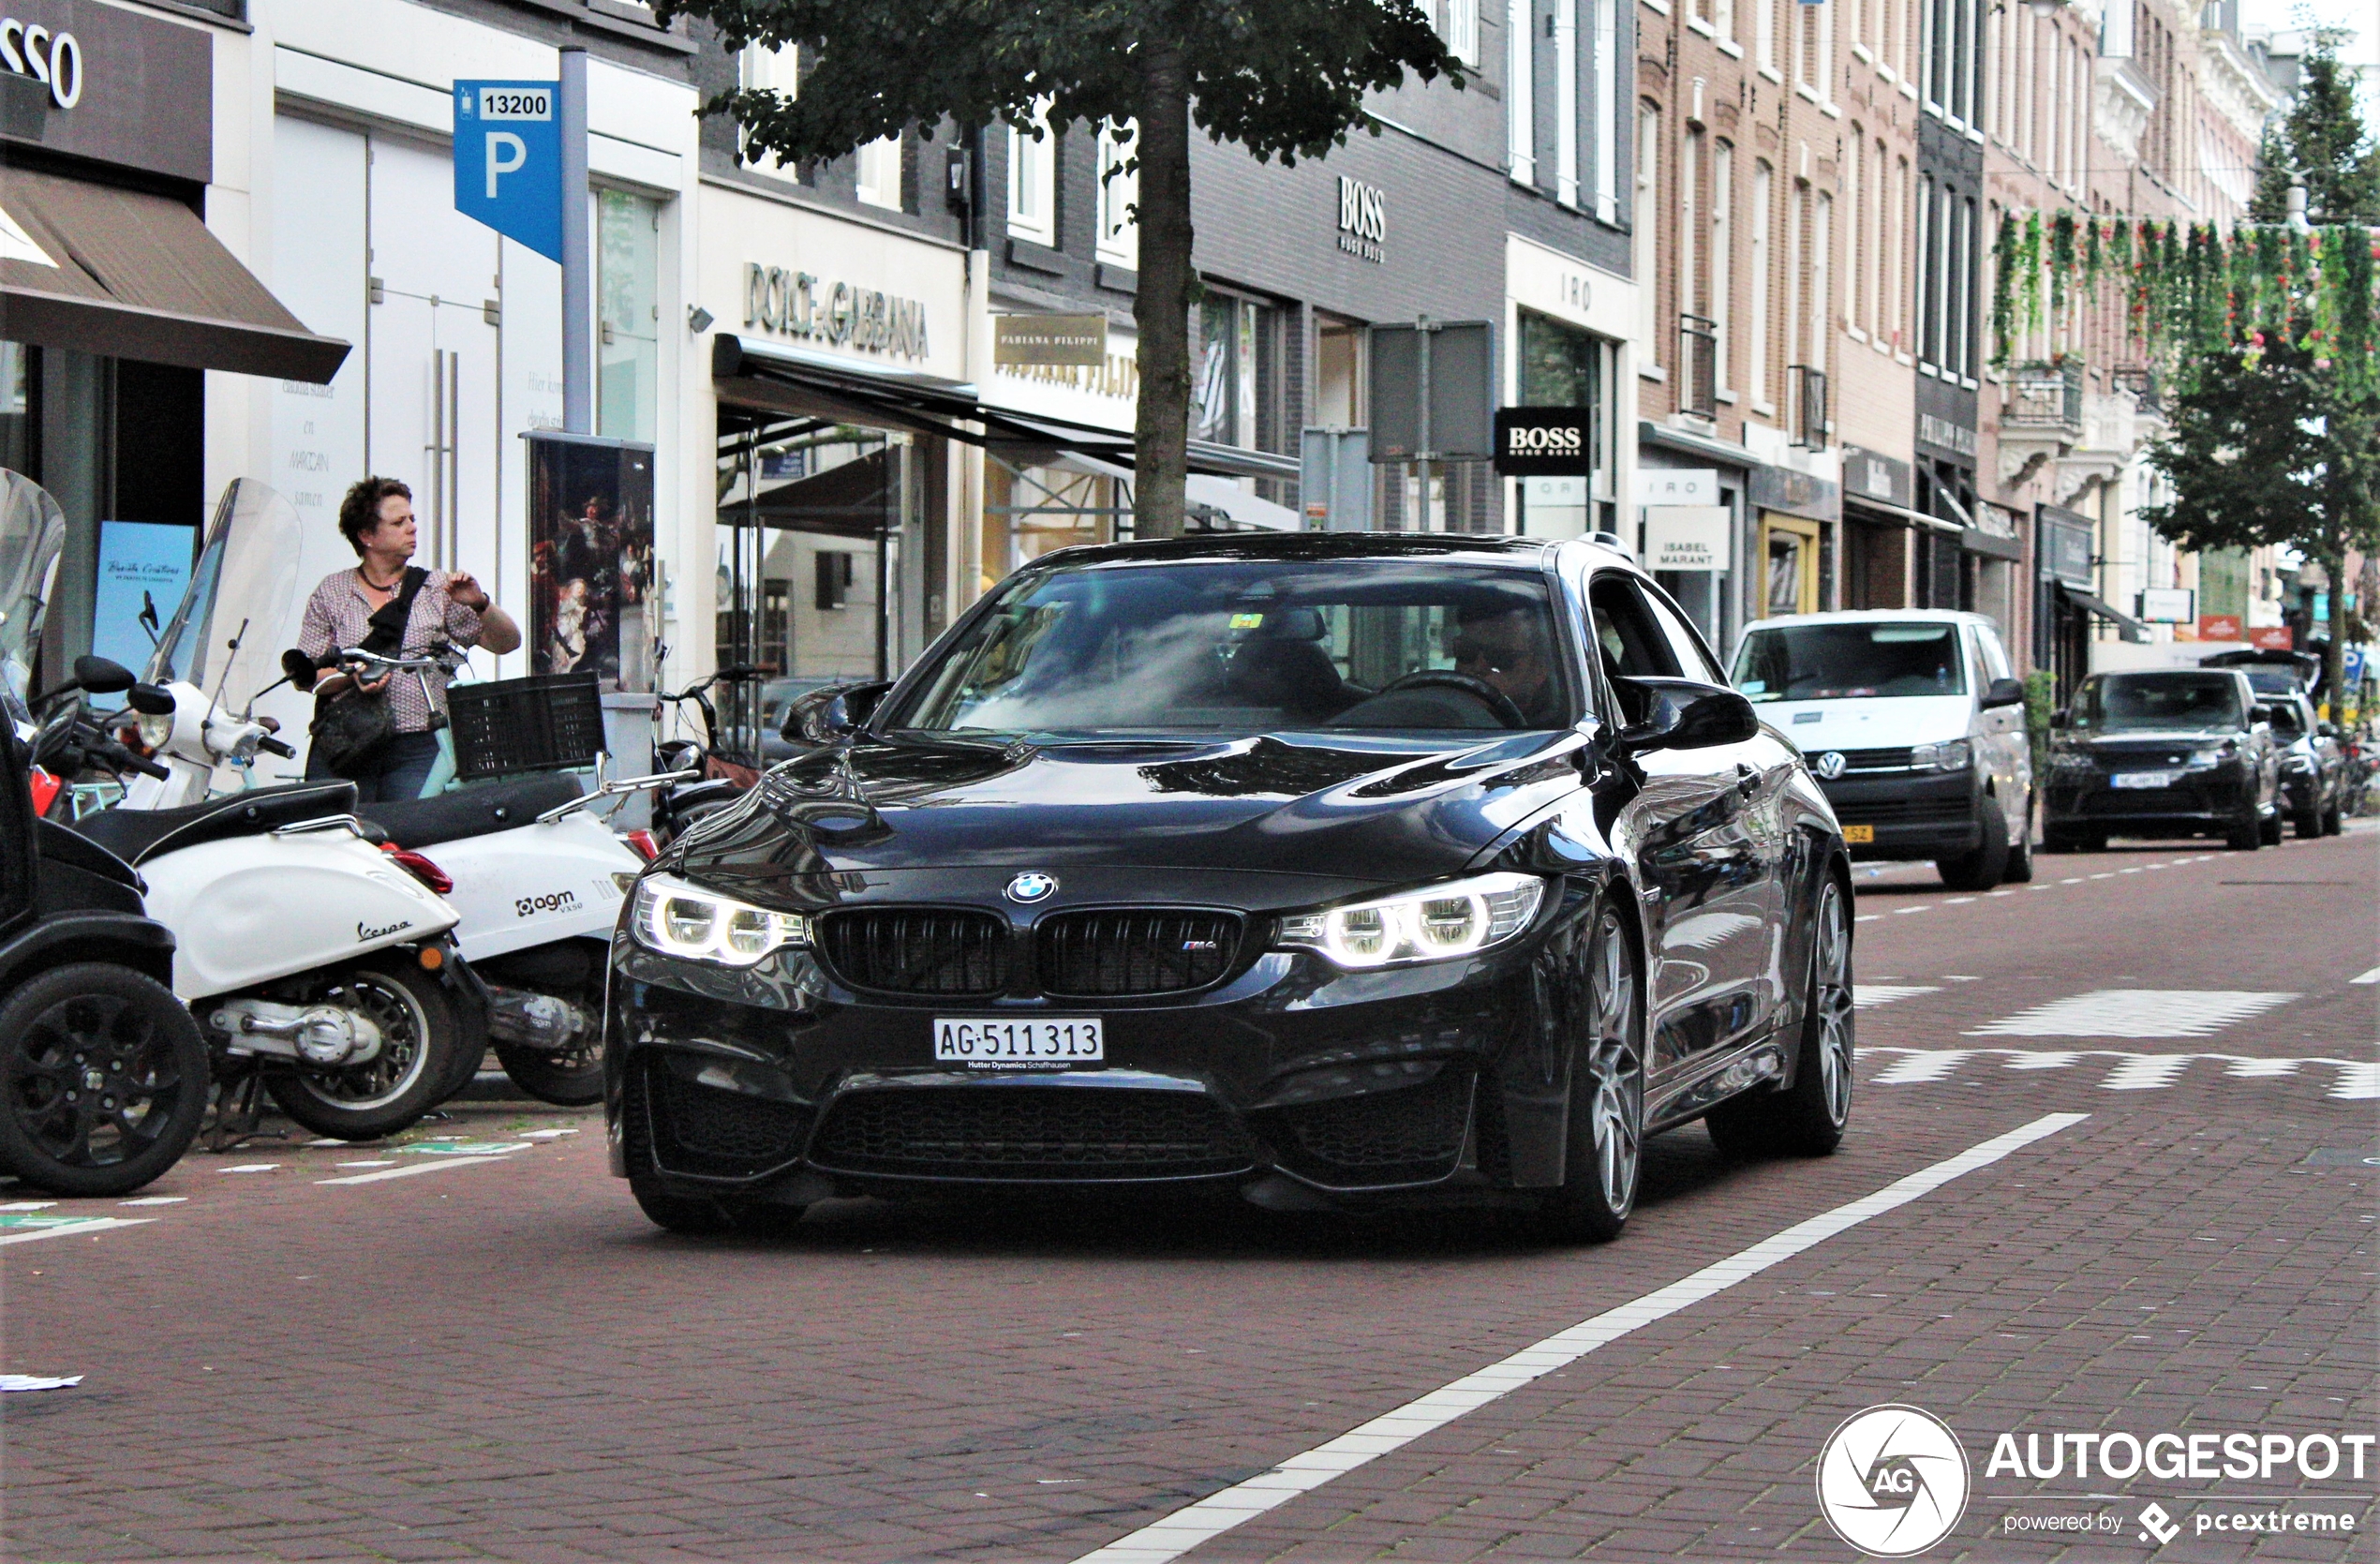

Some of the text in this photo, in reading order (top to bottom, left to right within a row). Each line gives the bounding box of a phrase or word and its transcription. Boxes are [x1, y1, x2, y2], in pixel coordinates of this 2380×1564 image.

[485, 96, 546, 114] 13200
[485, 132, 527, 199] P
[1339, 175, 1386, 243] BOSS
[1562, 273, 1591, 311] IRO
[1000, 335, 1049, 346] FABIANA
[1509, 427, 1582, 449] BOSS
[1649, 482, 1697, 494] IRO
[1664, 544, 1708, 553] ISABEL
[1660, 555, 1713, 564] MARANT
[534, 890, 574, 911] agm
[559, 902, 583, 914] VX50
[358, 921, 412, 943] Vespa
[991, 1061, 1027, 1070] Dynamics
